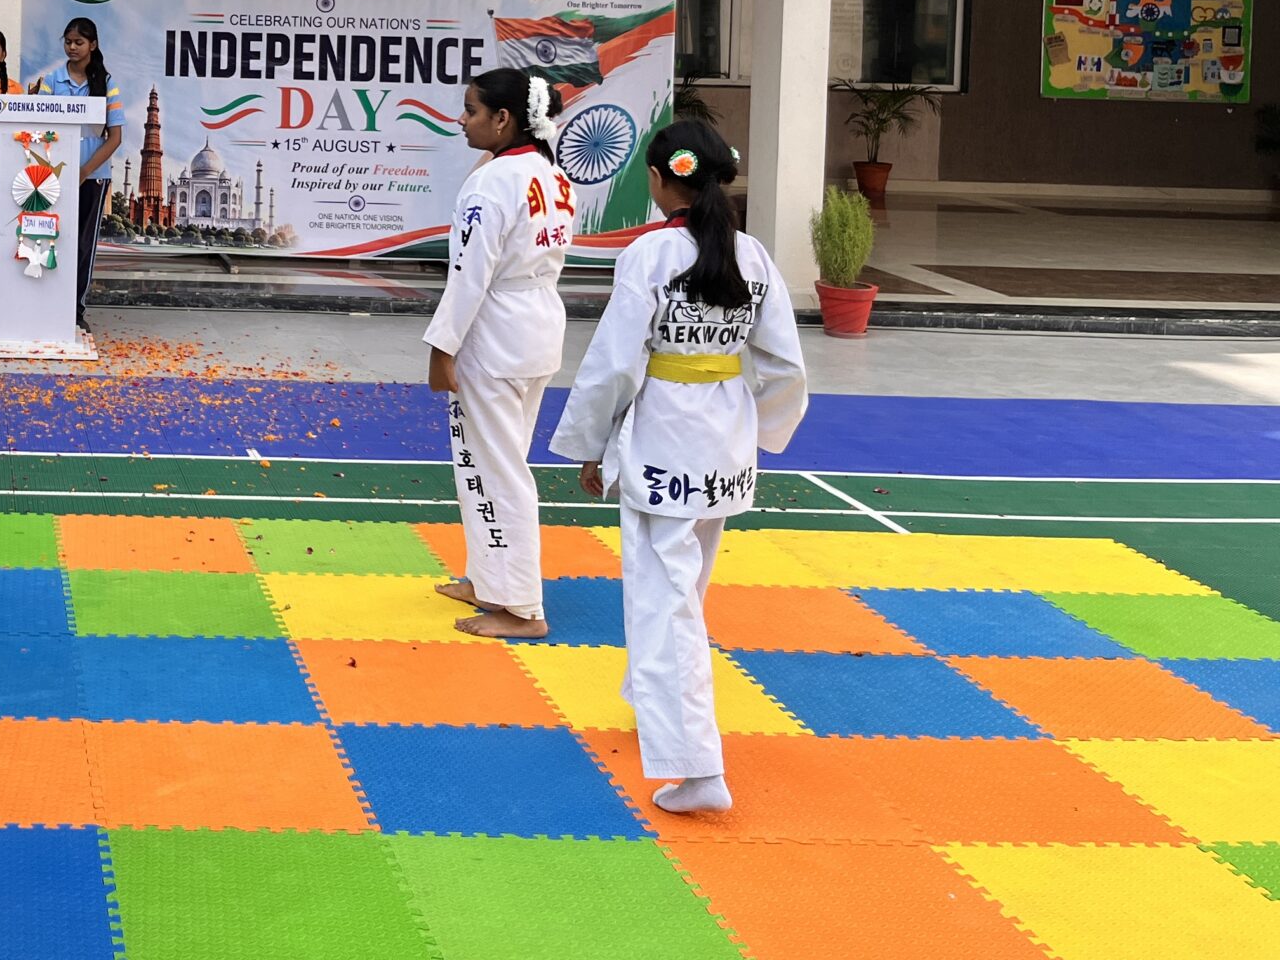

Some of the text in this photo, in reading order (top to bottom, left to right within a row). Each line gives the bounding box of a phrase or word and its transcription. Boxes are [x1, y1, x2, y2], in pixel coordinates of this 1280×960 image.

[566, 0, 581, 8] One
[581, 1, 609, 10] Brighter
[229, 13, 421, 31] CELEBRATING OUR NATION'S
[165, 30, 485, 85] INDEPENDENCE
[8, 102, 35, 112] GOENKA
[36, 102, 65, 115] SCHOOL,
[67, 103, 86, 113] BASTI
[275, 86, 392, 132] DAY
[284, 137, 381, 153] 15th AUGUST
[291, 162, 430, 177] Proud of our Freedom.
[290, 178, 433, 193] Inspired by our Future.
[318, 212, 333, 220] ONE
[309, 221, 324, 229] ONE
[325, 222, 361, 230] BRIGHTER
